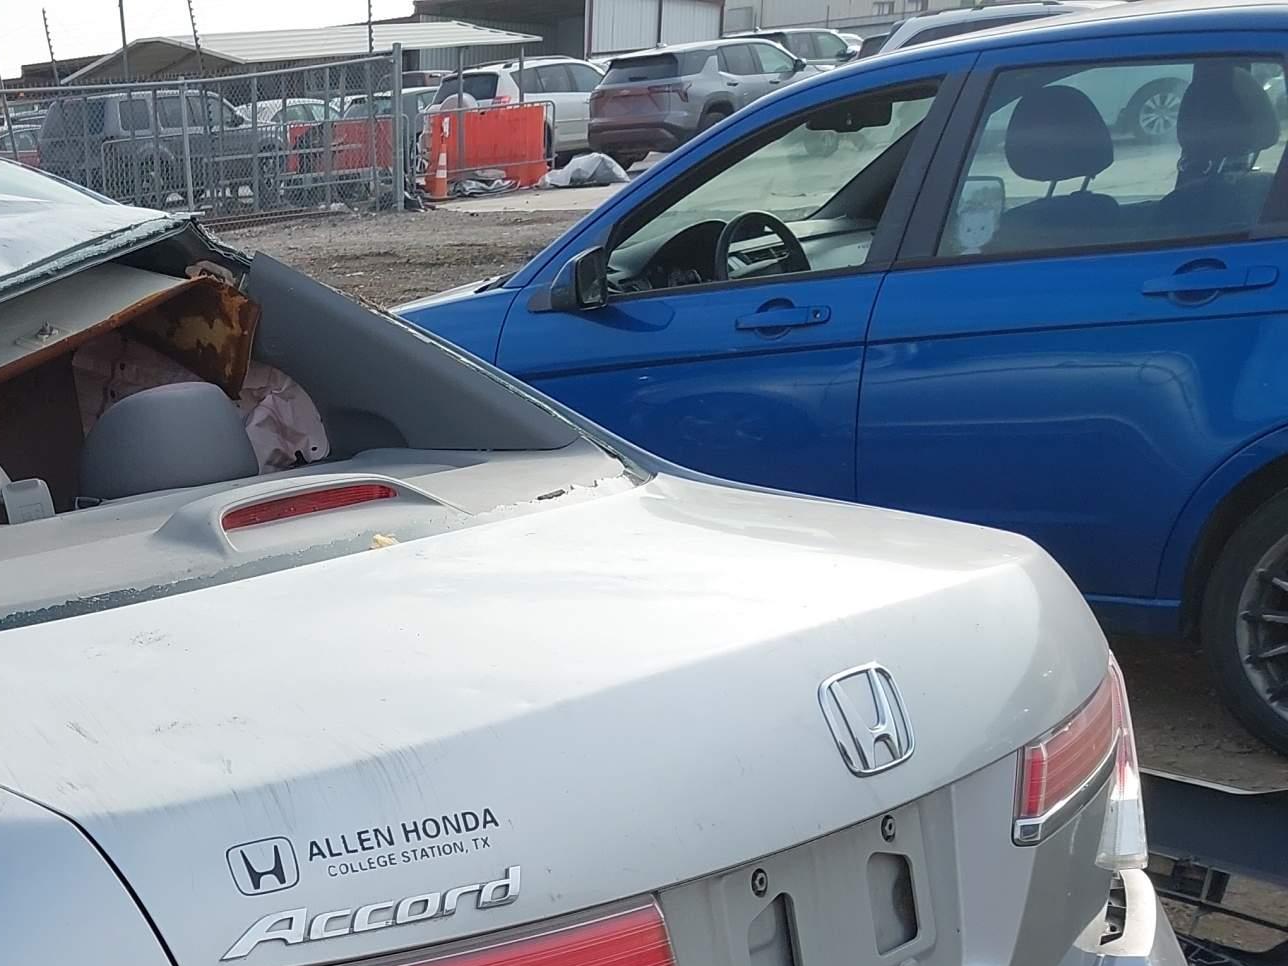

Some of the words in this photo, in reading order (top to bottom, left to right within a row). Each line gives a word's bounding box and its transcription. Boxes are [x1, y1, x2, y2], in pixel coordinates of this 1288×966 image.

[309, 825, 395, 861] ALLEN
[401, 808, 499, 843] HONDA
[327, 854, 398, 878] COLLEGE
[401, 841, 469, 864] STATION,
[472, 836, 491, 849] TX
[219, 865, 522, 962] Accord
